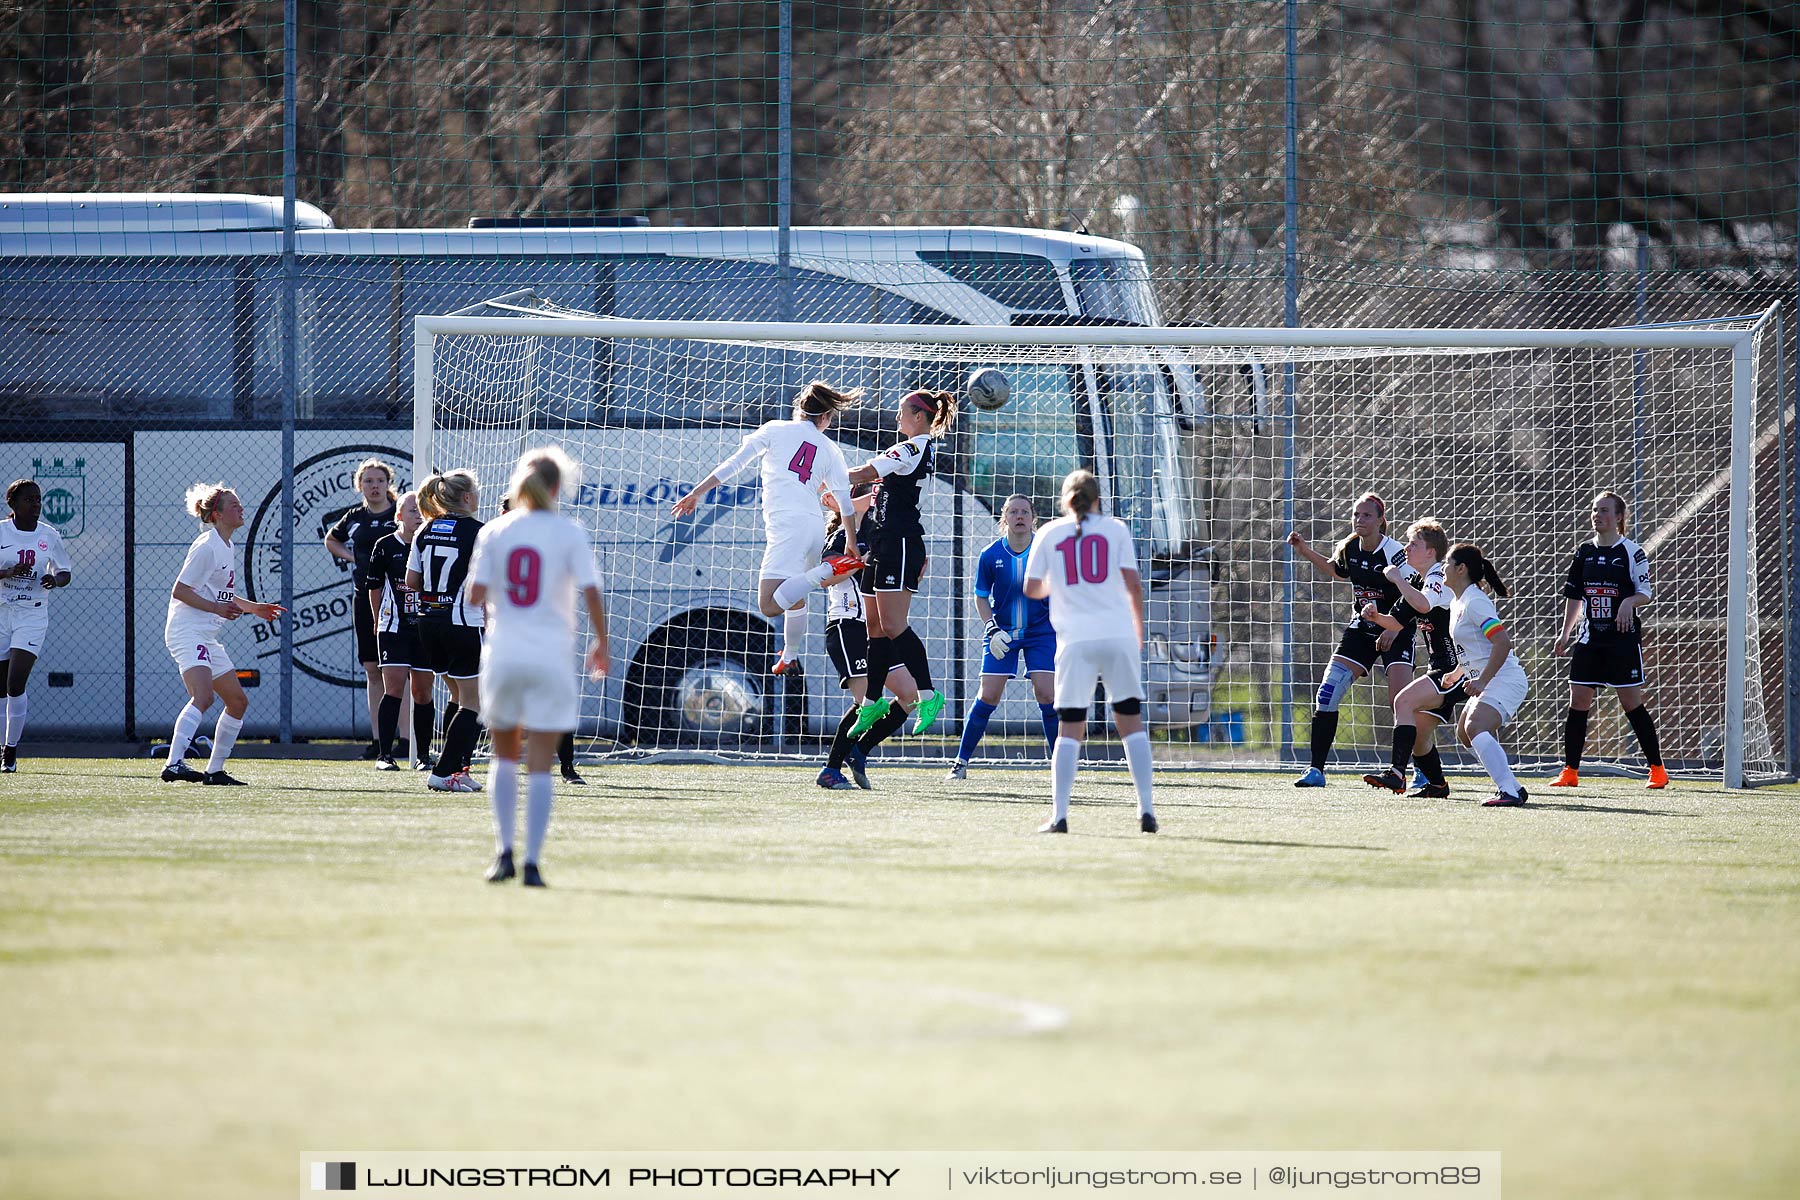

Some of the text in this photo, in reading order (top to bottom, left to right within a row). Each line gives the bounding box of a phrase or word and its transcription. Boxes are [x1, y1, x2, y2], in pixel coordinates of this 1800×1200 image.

[788, 441, 817, 485] 4
[421, 545, 459, 593] 17
[506, 546, 541, 607] 9
[1054, 534, 1109, 586] 10
[251, 594, 353, 645] BUSSBO
[855, 658, 867, 670] 23
